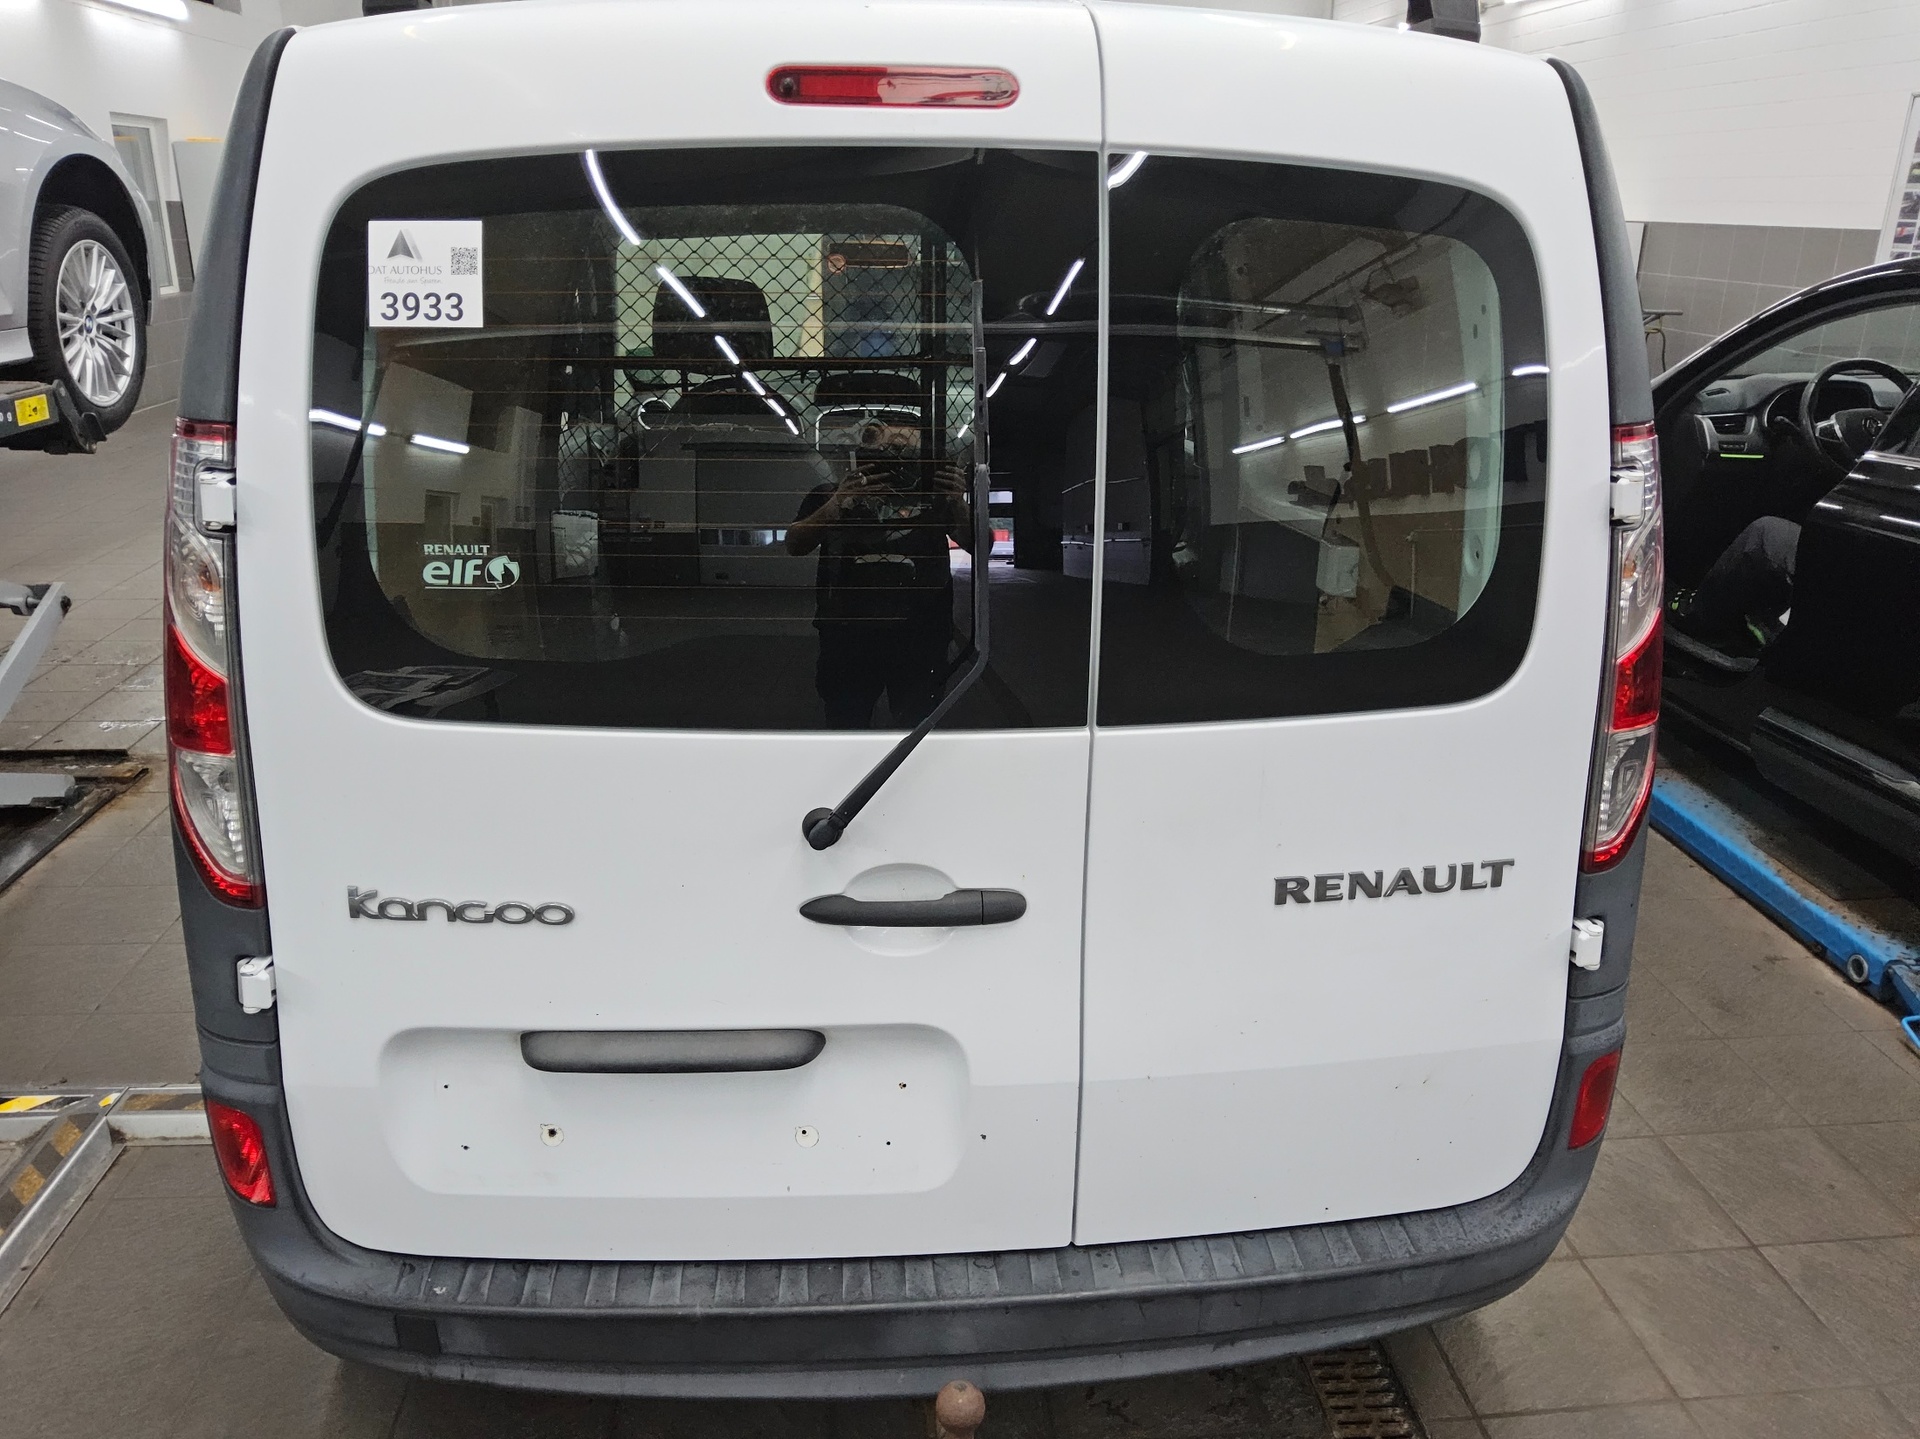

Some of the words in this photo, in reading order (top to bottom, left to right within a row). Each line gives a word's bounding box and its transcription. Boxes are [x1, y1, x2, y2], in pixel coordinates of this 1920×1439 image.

[368, 265, 386, 275] DAT
[390, 265, 442, 275] AUTOHUS
[380, 292, 464, 321] 3933
[423, 544, 490, 556] RENAULT
[422, 559, 483, 585] elf
[1273, 858, 1516, 905] RENAULT
